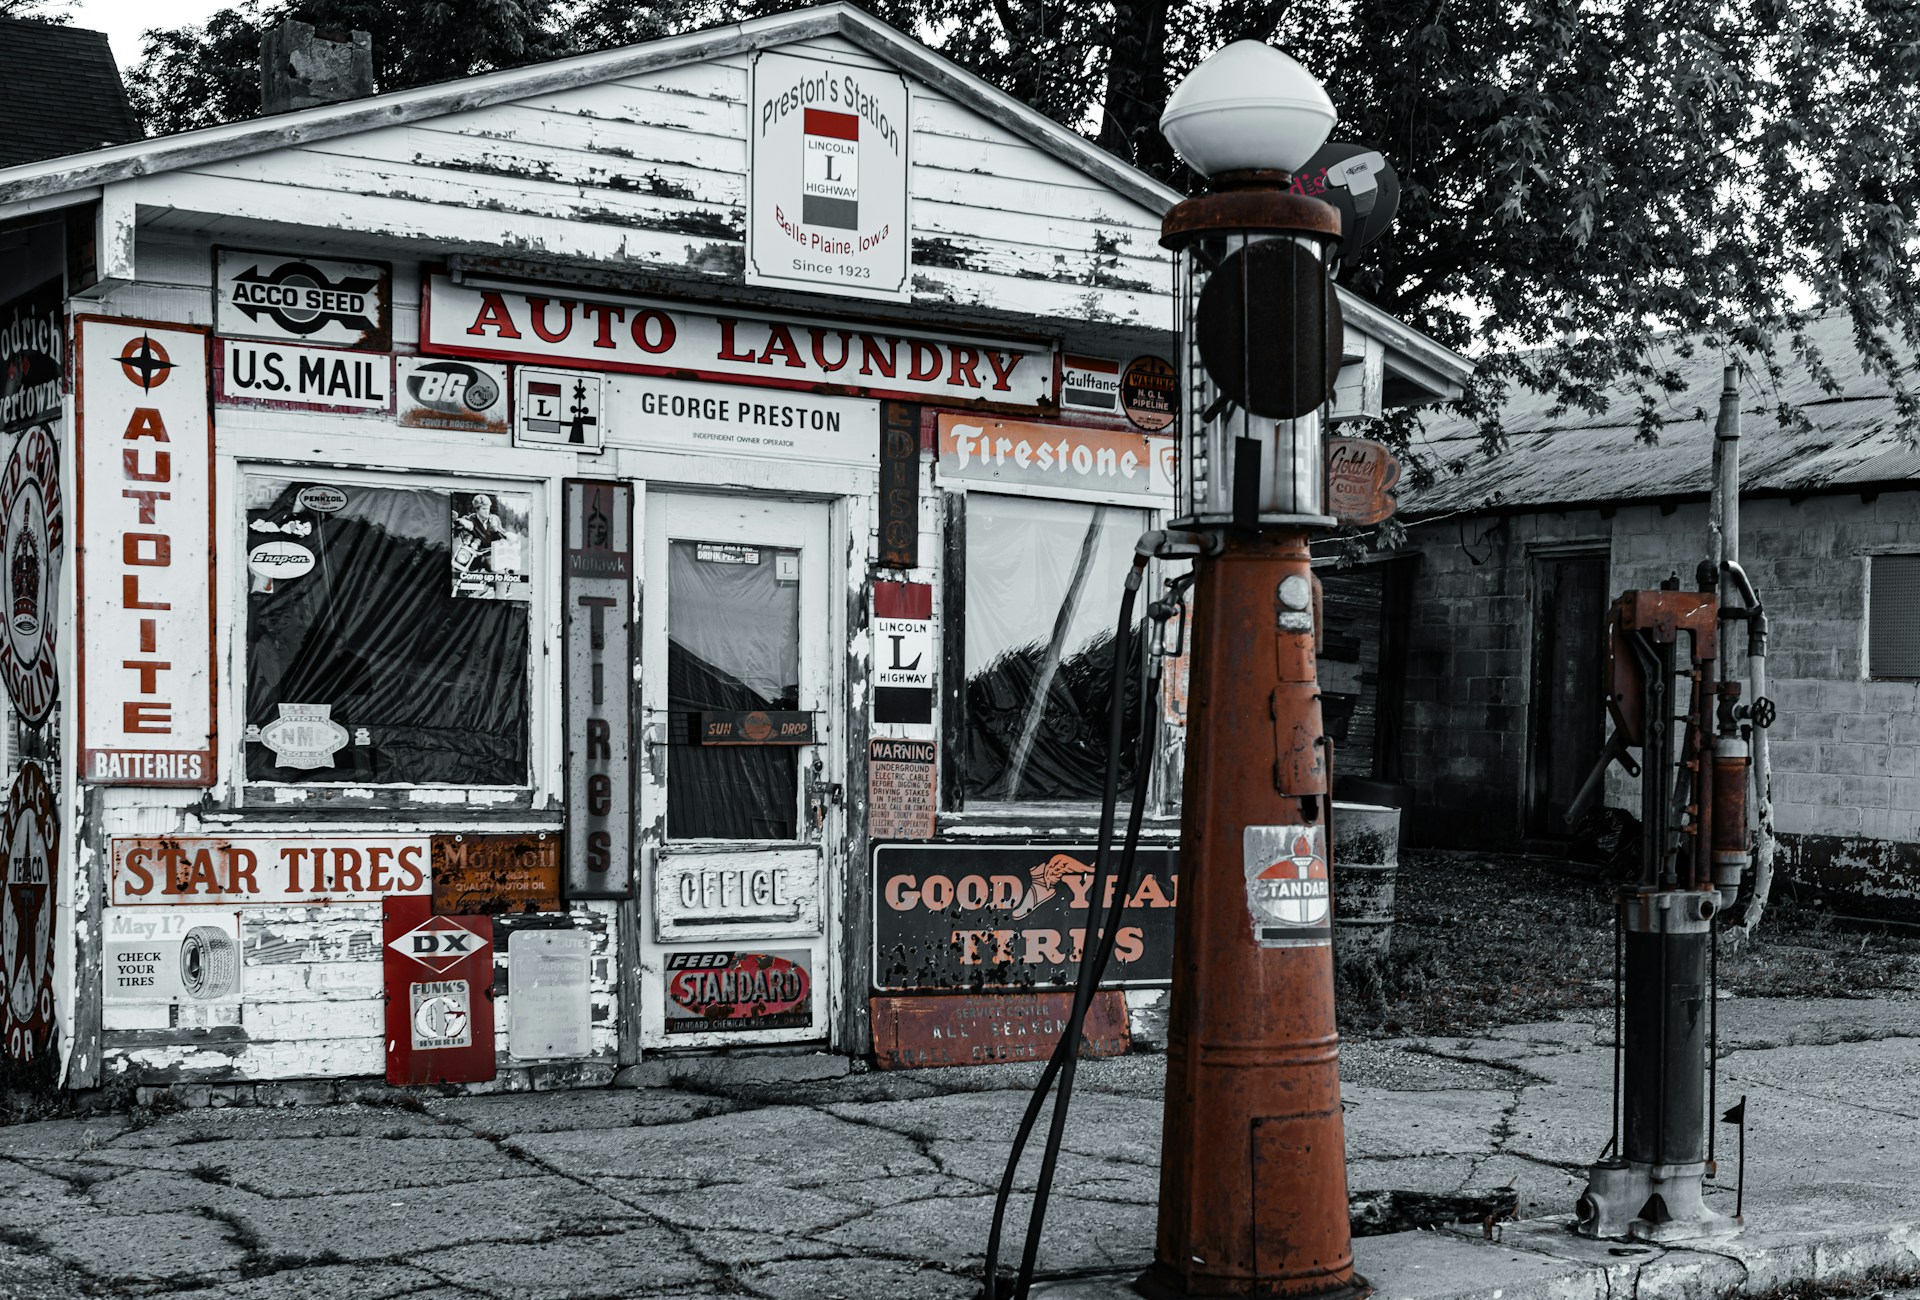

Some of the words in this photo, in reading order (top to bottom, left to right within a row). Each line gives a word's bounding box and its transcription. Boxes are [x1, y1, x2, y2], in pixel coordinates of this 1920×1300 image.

[762, 70, 839, 138] Preston's
[843, 75, 899, 158] Station
[808, 140, 855, 155] LINCOLN
[824, 155, 842, 182] L
[806, 182, 857, 198] HIGHWAY
[775, 204, 808, 246] Belle
[811, 233, 855, 257] Plaine,
[858, 224, 889, 252] Iowa
[792, 259, 833, 275] Since
[838, 263, 871, 279] 1923
[231, 283, 298, 307] ACCO
[305, 288, 365, 314] SEED
[466, 291, 677, 354] AUTO
[716, 317, 1024, 392] LAUNDRY
[233, 348, 292, 393] U.S.
[299, 354, 384, 401] MAIL
[1066, 370, 1118, 392] Gulftane
[1133, 374, 1174, 392] WARNING
[537, 399, 552, 417] L
[1132, 398, 1169, 411] PIPELINE
[641, 392, 730, 422] GEORGE
[738, 402, 841, 433] PRESTON
[692, 431, 734, 442] INDEPENDENT
[736, 435, 761, 445] OWNER
[762, 438, 795, 448] OPERATOR
[950, 423, 1139, 480] Firestone
[1336, 483, 1366, 495] COLA
[303, 495, 344, 503] PENNZOIL
[252, 552, 311, 566] Snap-on
[697, 550, 721, 561] DRINK
[122, 407, 172, 734] AUTOLITE
[570, 554, 626, 573] Mohawk
[783, 561, 793, 575] L
[460, 572, 483, 580] Come
[484, 574, 494, 582] up
[495, 573, 503, 581] to
[879, 621, 927, 633] LINCOLN
[888, 635, 922, 671] L
[880, 672, 928, 684] HIGHWAY
[708, 722, 732, 735] SUN
[781, 722, 808, 735] DROP
[872, 742, 934, 761] WARNING
[95, 752, 202, 779] BATTERIES
[875, 763, 930, 773] UNDERGROUND
[875, 771, 905, 780] ELECTRIC
[909, 773, 929, 782] CABLE
[871, 780, 894, 788] BEFORE
[897, 781, 920, 789] DIGGING
[924, 782, 932, 790] OR
[873, 787, 901, 796] DRIVING
[905, 789, 930, 797] STAKES
[876, 795, 884, 803] IN
[887, 796, 903, 804] THIS
[913, 804, 934, 812] CONTACT
[124, 847, 261, 897] STAR
[279, 845, 424, 893] TIRES
[531, 880, 547, 891] OIL
[680, 869, 789, 909] OFFICE
[884, 873, 1024, 912] GOOD
[1060, 873, 1180, 910] YEA
[111, 916, 157, 939] May
[411, 933, 471, 953] DX
[556, 937, 586, 949] OUTE
[117, 952, 161, 963] CHECK
[671, 953, 730, 969] FEED
[118, 964, 155, 975] YOUR
[538, 961, 581, 973] PARKING
[117, 976, 155, 987] TIRES
[412, 982, 466, 995] FUNK'S
[678, 967, 804, 1006] STANDARD
[955, 1006, 1002, 1019] SERVICE
[1006, 1005, 1050, 1017] CENTER
[672, 1018, 710, 1031] STANDARD
[712, 1017, 748, 1028] CHEMICAL
[932, 1022, 970, 1040] ALL
[991, 1018, 1067, 1037] SEASON
[418, 1036, 465, 1047] HYBRID
